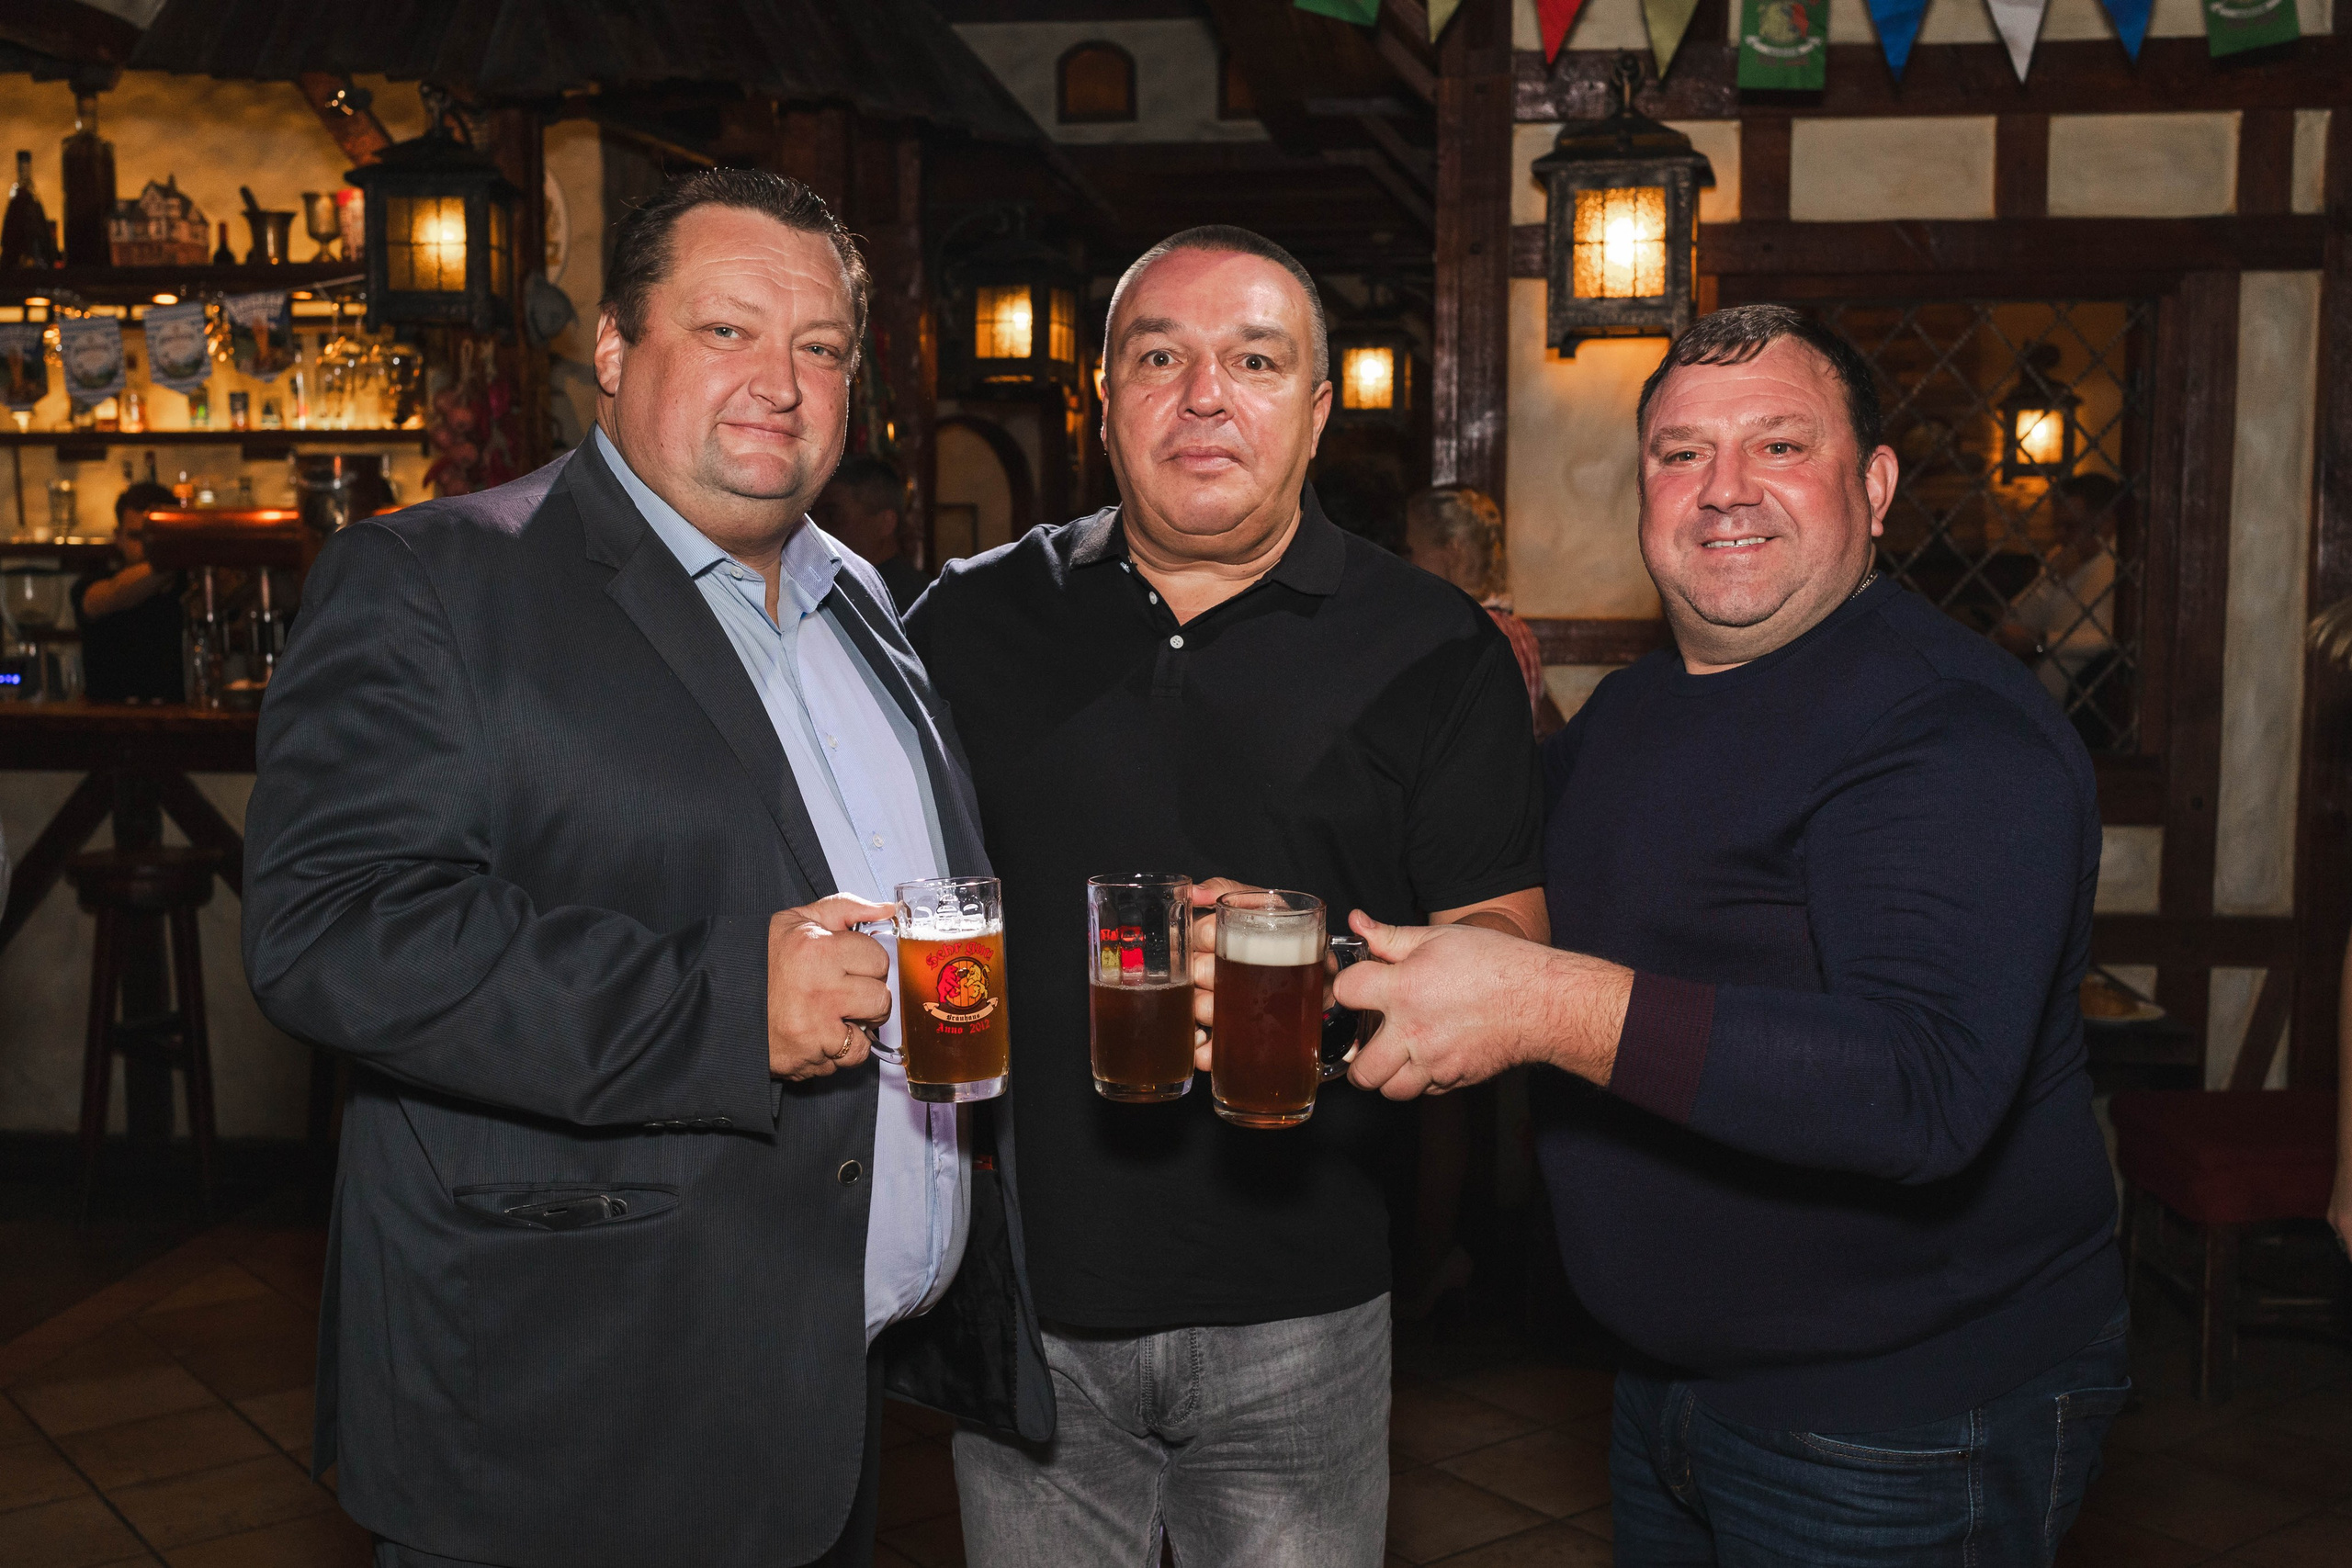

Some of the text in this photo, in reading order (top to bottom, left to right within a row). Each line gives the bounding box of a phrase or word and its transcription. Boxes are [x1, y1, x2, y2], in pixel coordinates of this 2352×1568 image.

[926, 942, 962, 970] Sehr
[936, 1018, 990, 1034] Anno 2012
